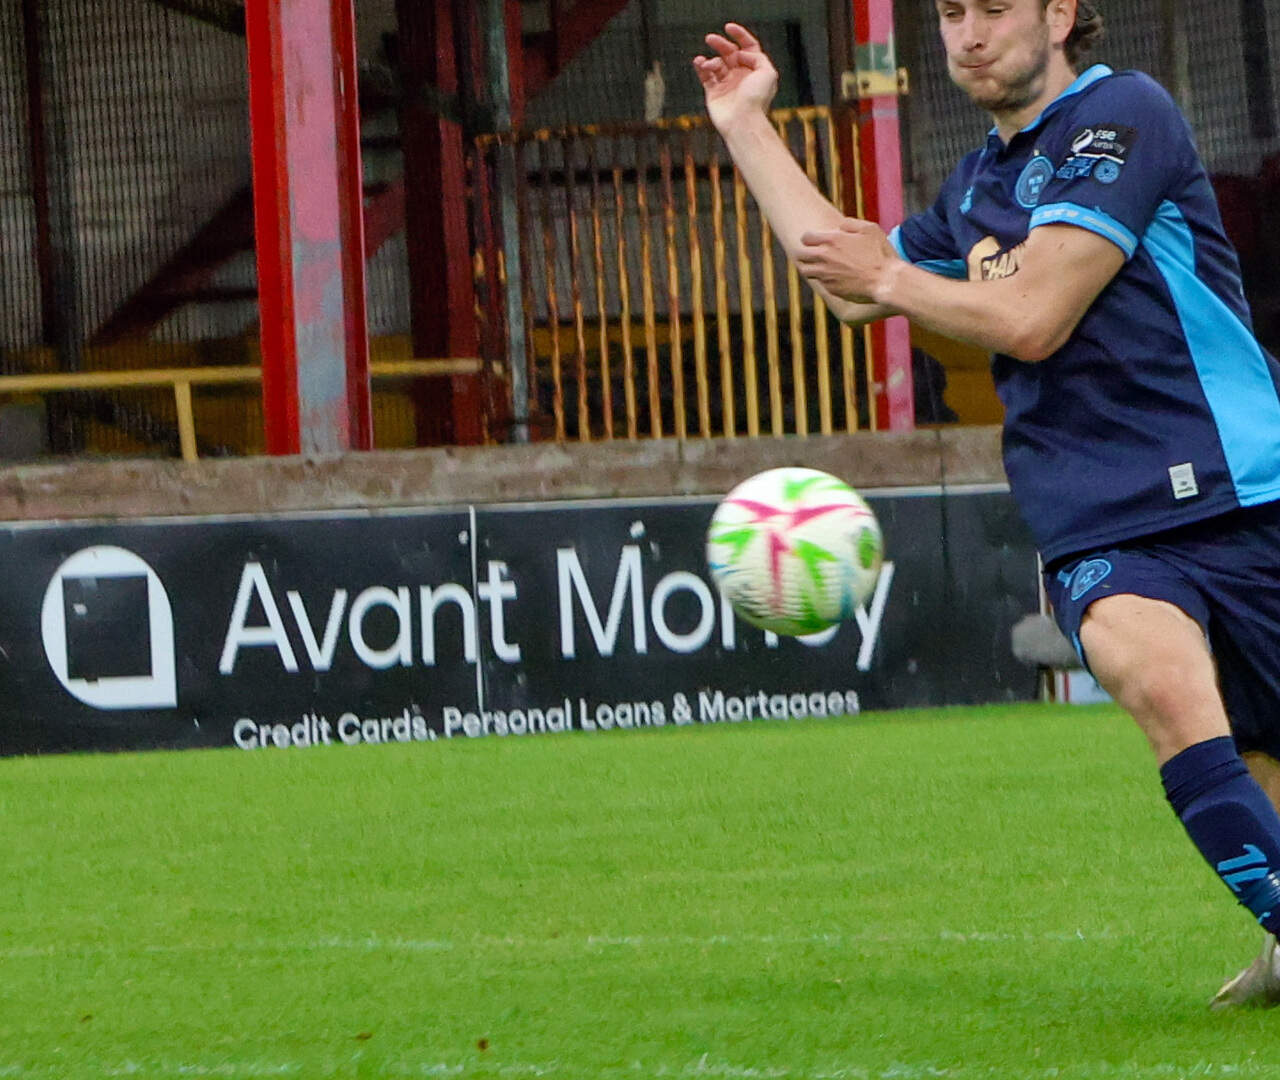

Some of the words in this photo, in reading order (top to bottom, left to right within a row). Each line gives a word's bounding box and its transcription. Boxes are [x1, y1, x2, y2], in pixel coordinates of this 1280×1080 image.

[218, 560, 522, 674] Avant
[233, 712, 333, 751] Credit
[337, 704, 439, 746] Cards,
[442, 697, 573, 738] Personal
[580, 697, 666, 732] Loans
[672, 692, 694, 726] &
[699, 689, 860, 725] Mortgages
